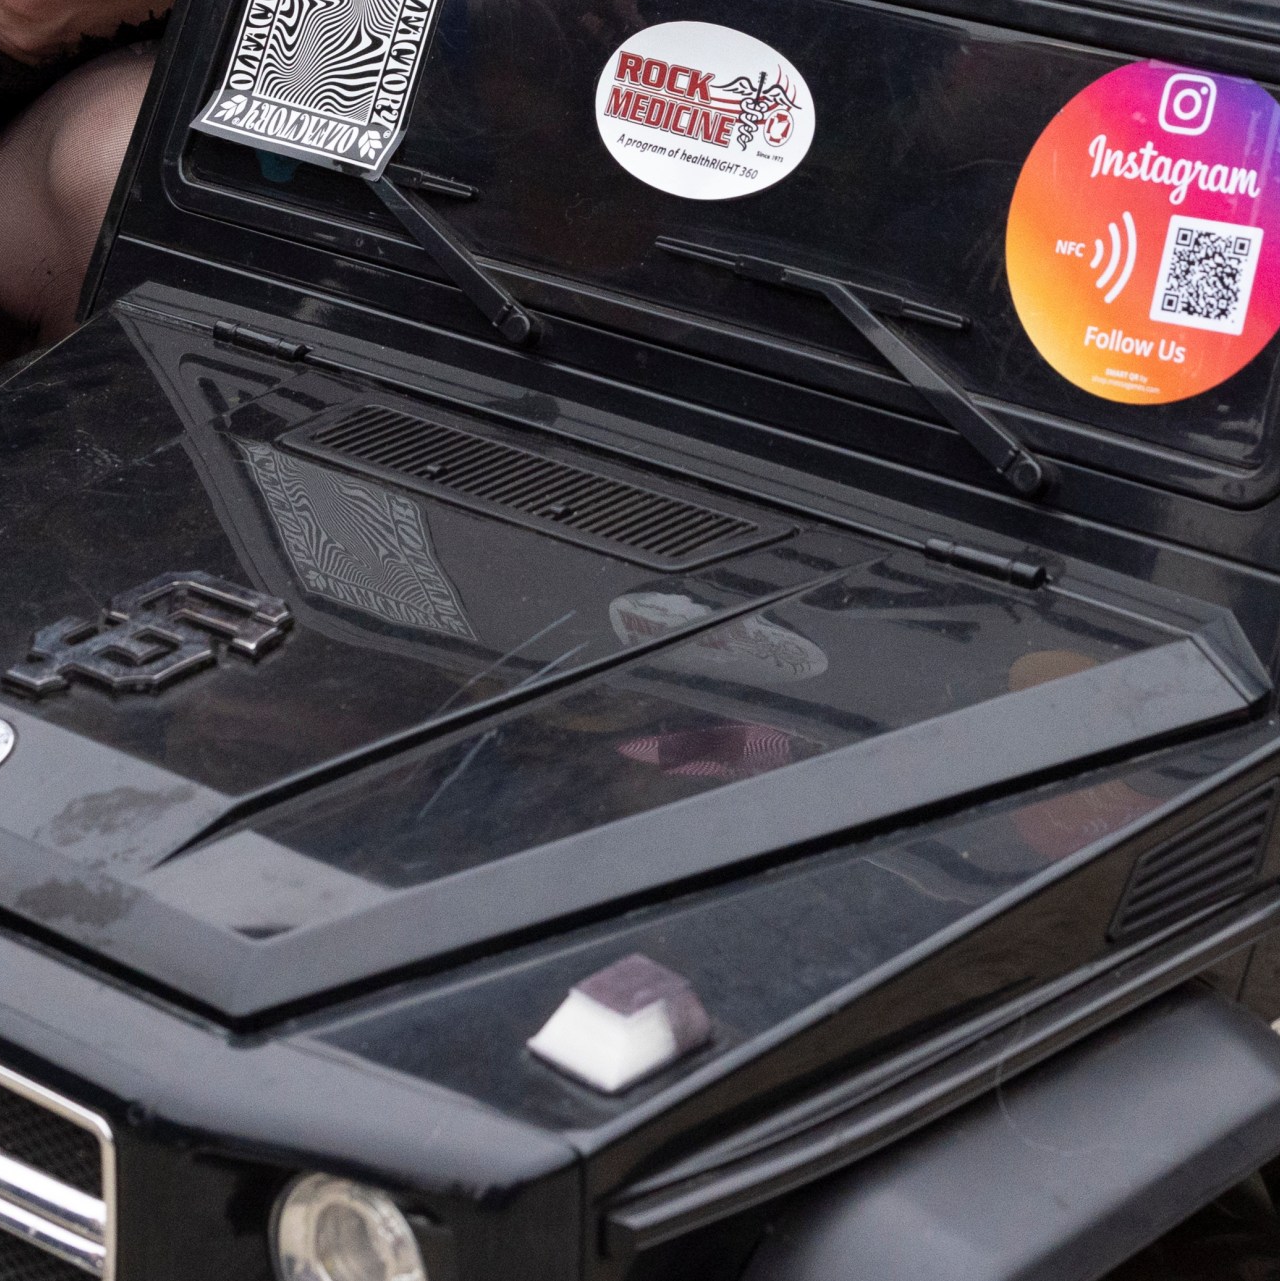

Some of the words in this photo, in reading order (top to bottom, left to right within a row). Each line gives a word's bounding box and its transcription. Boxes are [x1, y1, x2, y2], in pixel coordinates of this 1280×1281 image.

[614, 51, 715, 104] ROCK
[604, 85, 738, 148] MEDICINE
[616, 133, 625, 144] A
[624, 138, 667, 156] program
[667, 148, 680, 159] of
[681, 149, 741, 175] healthRIGHT
[739, 167, 759, 180] 360
[756, 150, 770, 160] Since
[1088, 134, 1261, 206] Instagram
[1055, 239, 1086, 258] NFC
[1084, 325, 1155, 358] Follow
[1158, 338, 1187, 364] Us
